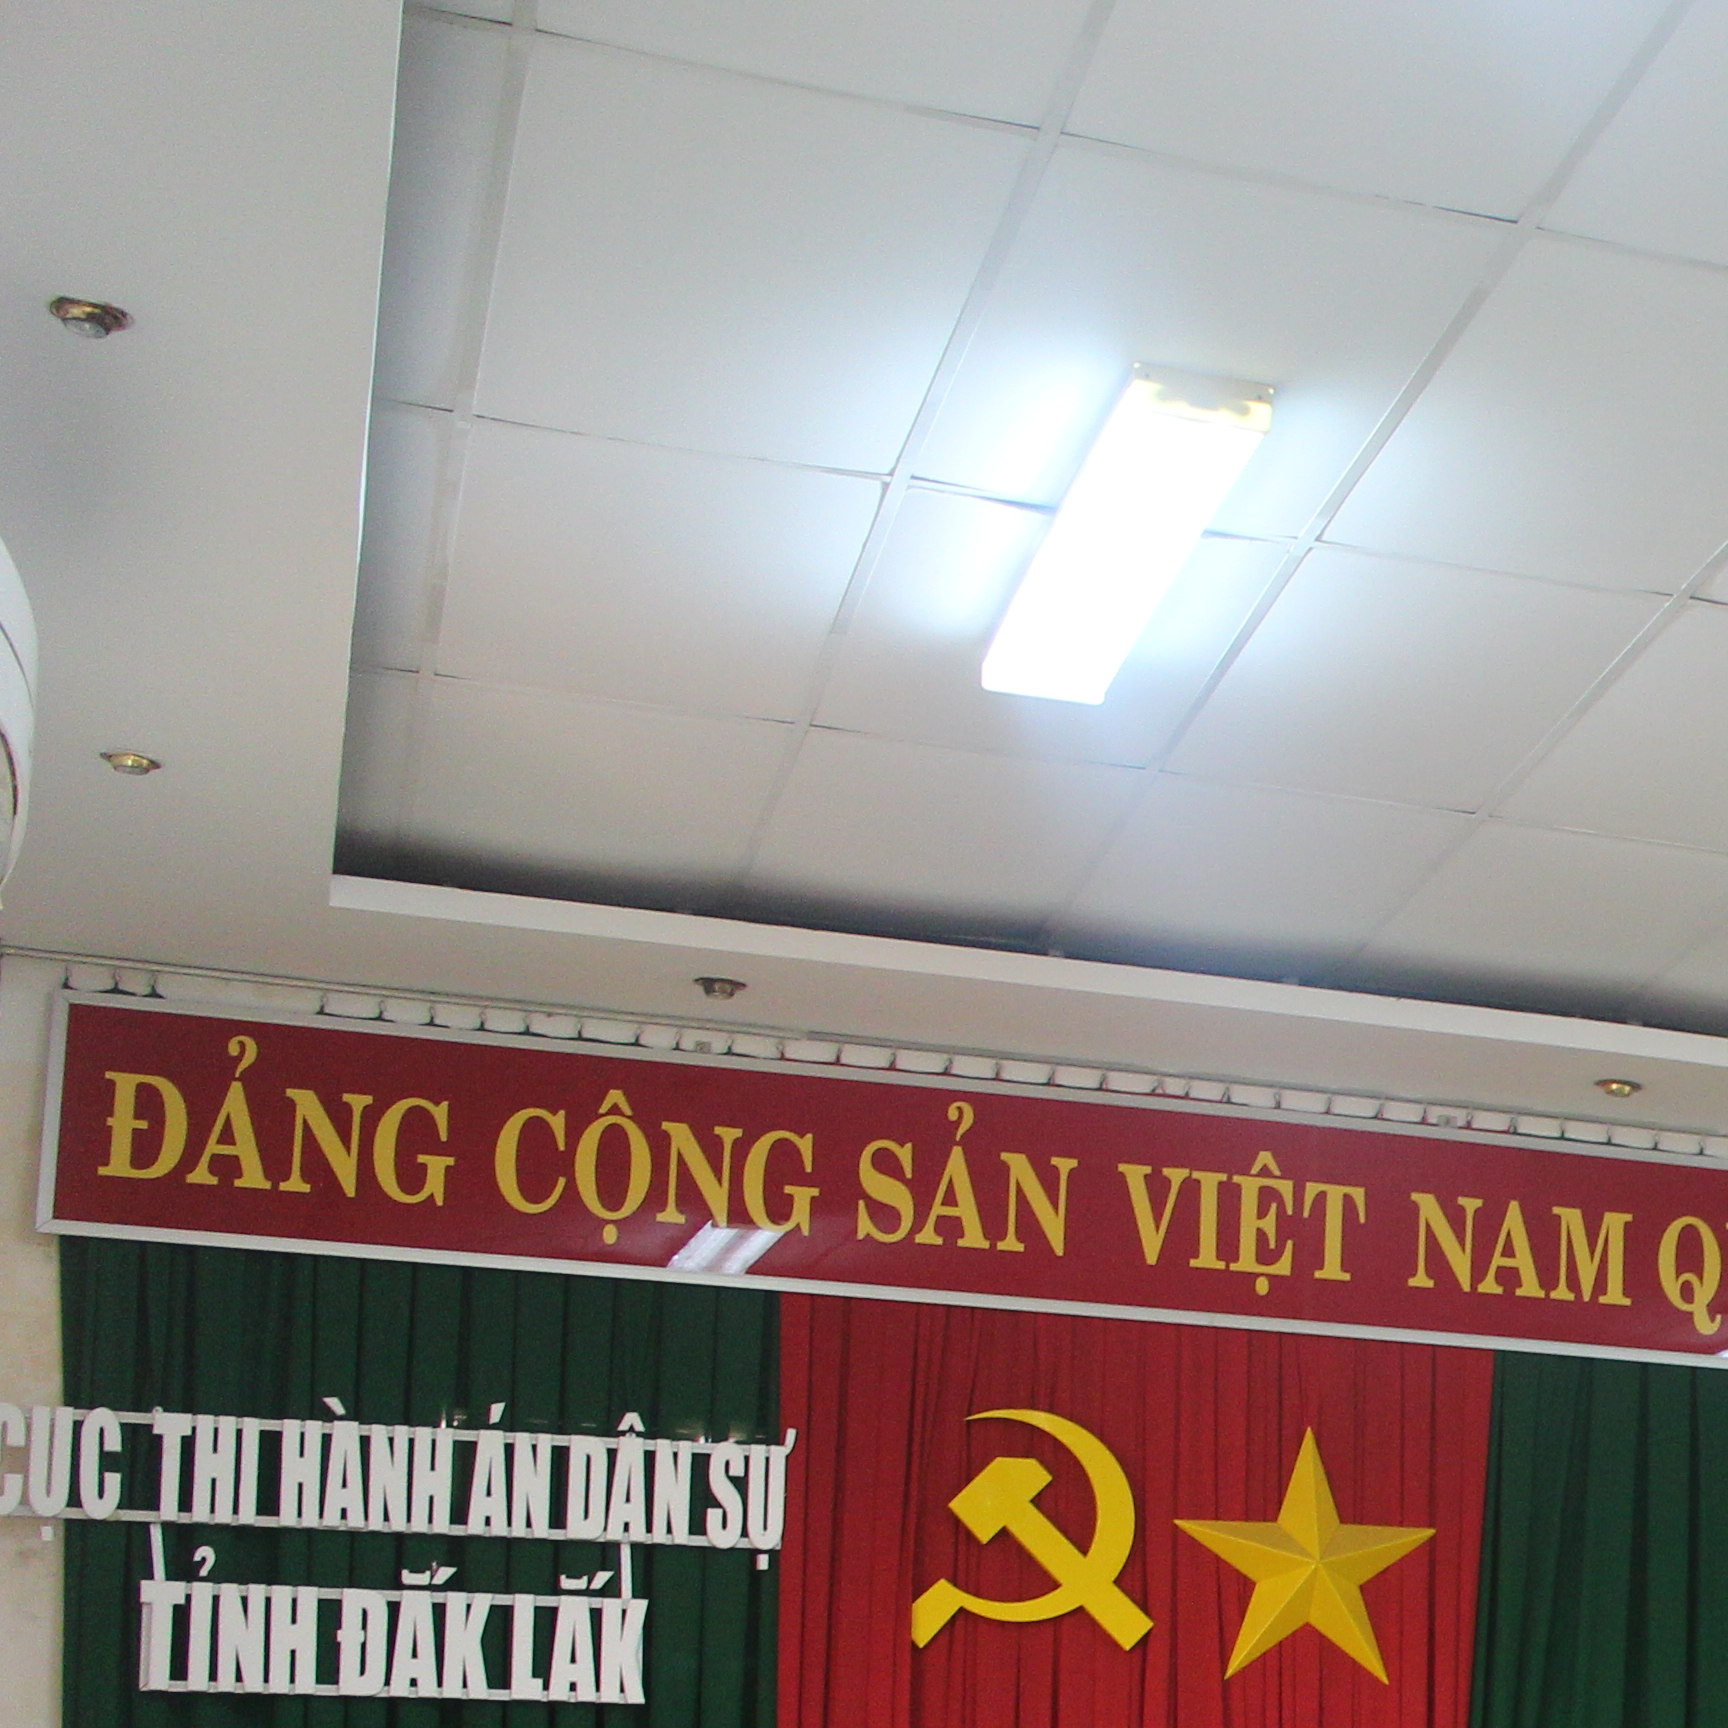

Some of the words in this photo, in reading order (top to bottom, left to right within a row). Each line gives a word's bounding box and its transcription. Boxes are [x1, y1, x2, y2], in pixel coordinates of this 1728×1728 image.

[97, 1036, 455, 1207] ĐẢNG
[493, 1090, 820, 1247] CỘNG
[854, 1100, 1078, 1259] SẢN
[1119, 1151, 1368, 1296] VIỆT
[1407, 1190, 1634, 1307] NAM
[152, 1411, 261, 1524] THI
[279, 1397, 454, 1534] HÀNH
[467, 1402, 552, 1538] ÁN
[566, 1412, 693, 1545] DÂN
[706, 1428, 797, 1570] SỰ
[140, 1546, 319, 1694] TỈNH
[337, 1567, 494, 1699] ĐẮK
[511, 1571, 649, 1704] LẮK
